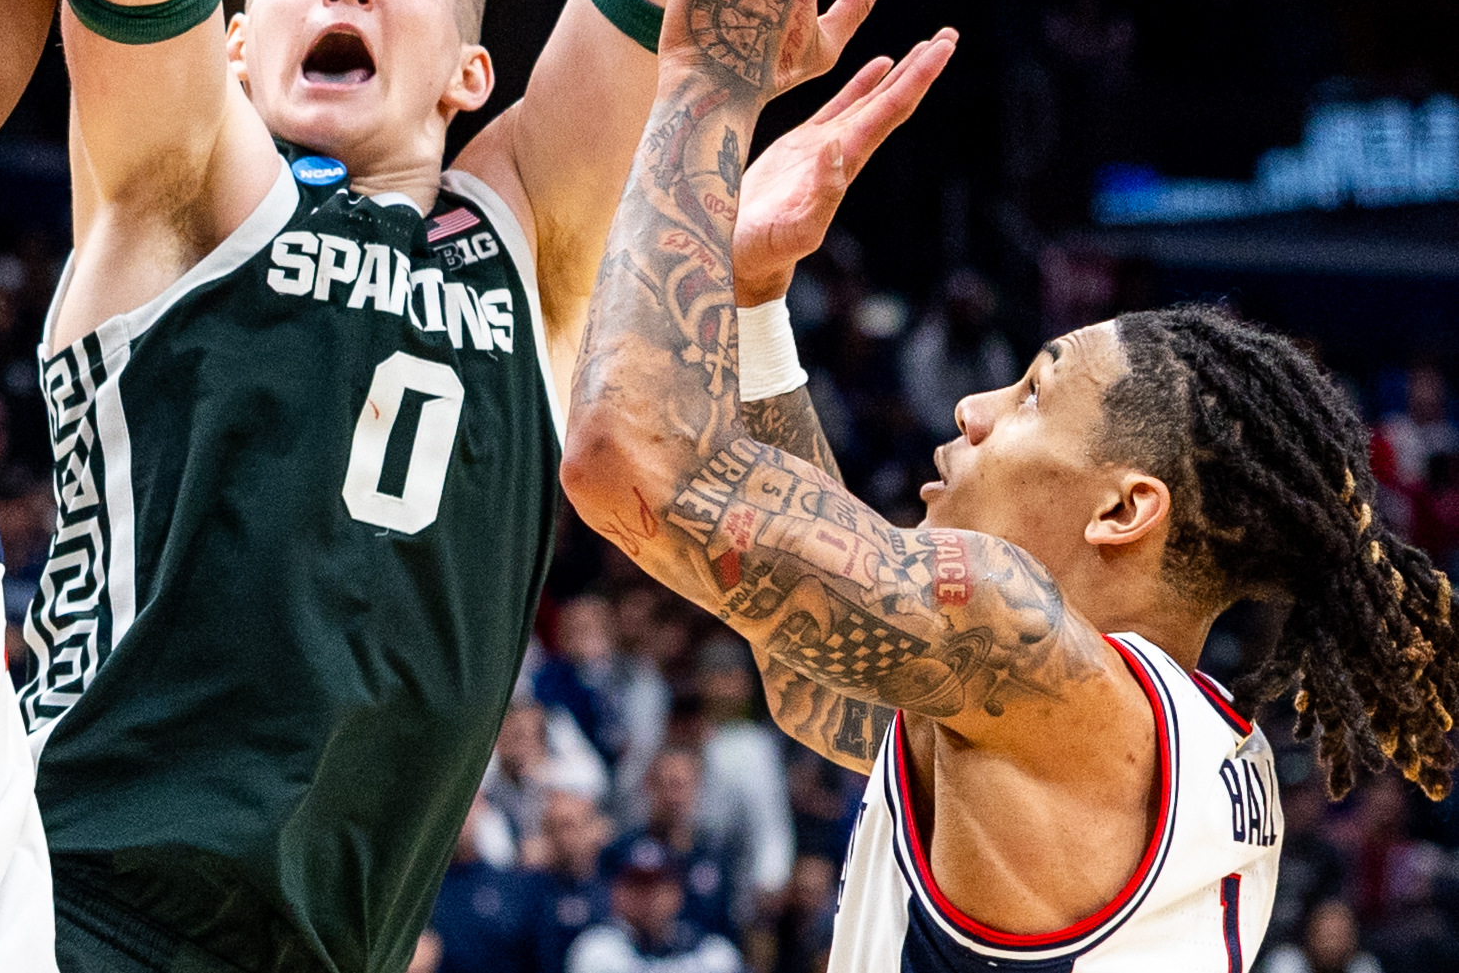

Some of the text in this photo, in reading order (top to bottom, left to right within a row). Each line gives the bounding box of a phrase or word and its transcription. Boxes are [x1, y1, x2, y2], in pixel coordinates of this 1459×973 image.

[299, 166, 344, 179] NCAA
[342, 350, 464, 535] 0
[665, 436, 763, 546] URNEY
[928, 529, 967, 601] RACE
[1219, 758, 1277, 848] BALL
